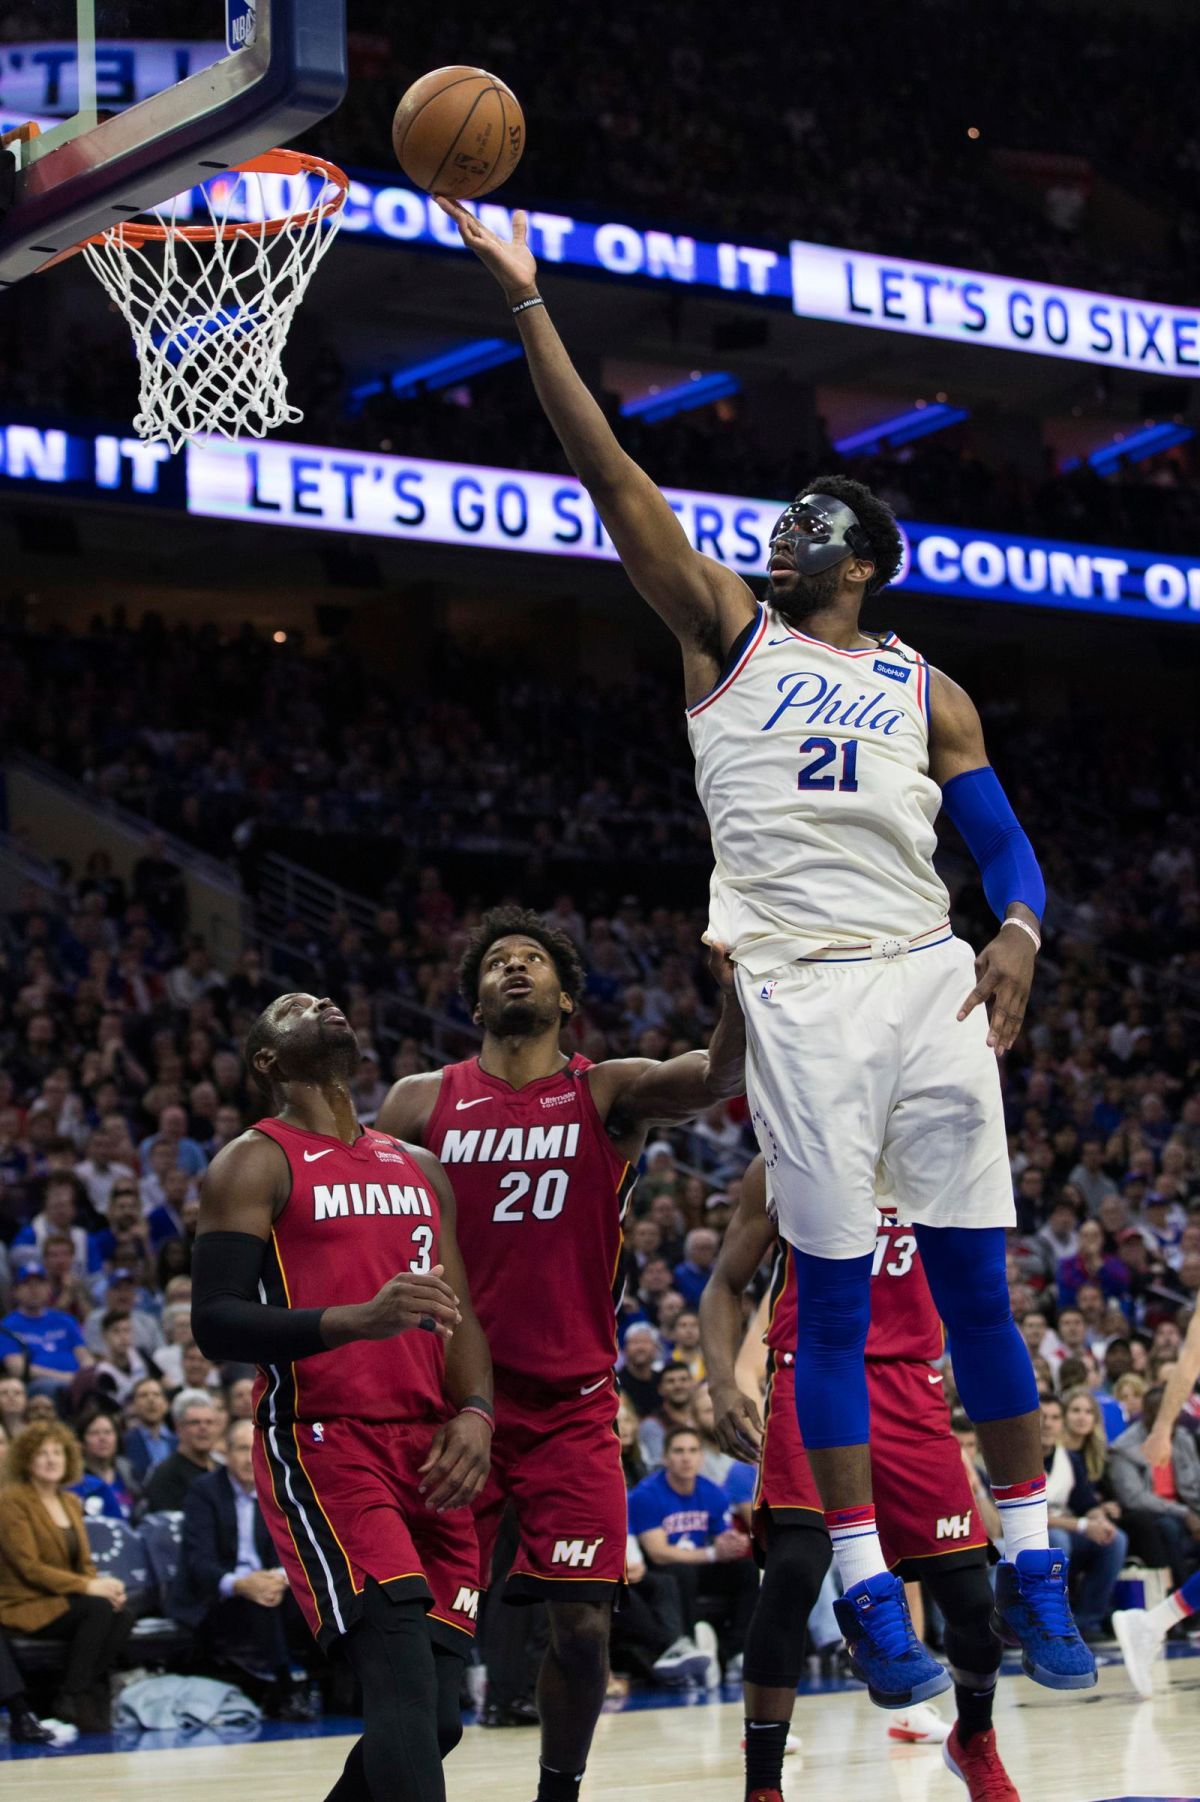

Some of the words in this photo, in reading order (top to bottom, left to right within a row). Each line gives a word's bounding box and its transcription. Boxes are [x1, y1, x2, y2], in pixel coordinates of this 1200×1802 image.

[593, 223, 696, 283] ON
[717, 243, 778, 295] IT
[844, 262, 987, 332] LET'S
[1008, 291, 1069, 345] GO
[1088, 304, 1200, 366] SIXE
[0, 424, 67, 482] N
[95, 435, 170, 494] IT
[246, 451, 426, 526] LET'S
[451, 476, 528, 537] GO
[552, 487, 761, 563] SIRS
[917, 535, 1128, 602] COUNT
[876, 664, 905, 679] StubHub
[761, 672, 905, 736] Phila
[797, 737, 858, 792] 21
[440, 1124, 580, 1163] MIAMI
[313, 1183, 432, 1221] MIAMI
[492, 1169, 569, 1222] 20
[409, 1225, 434, 1275] 3
[871, 1235, 917, 1276] 13
